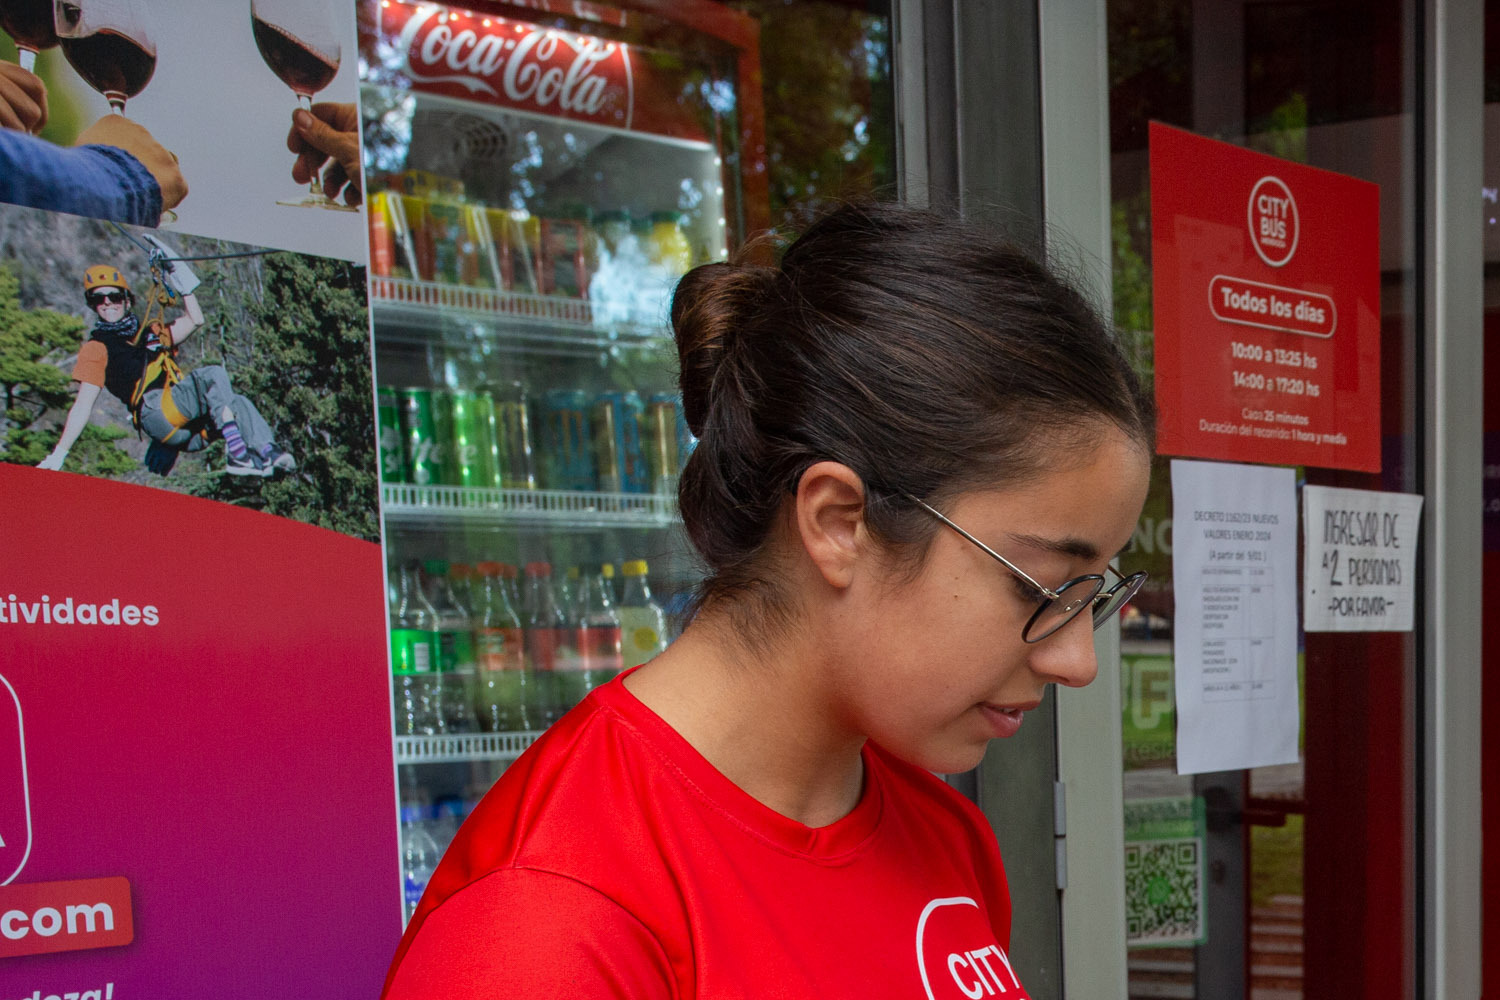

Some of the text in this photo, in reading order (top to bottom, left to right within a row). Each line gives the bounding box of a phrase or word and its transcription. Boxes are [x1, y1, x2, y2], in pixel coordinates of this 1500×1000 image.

[401, 2, 608, 115] Coca-Cola
[1257, 194, 1289, 220] CITY
[1260, 217, 1287, 240] BUS
[1221, 287, 1325, 324] Todos los días
[1231, 341, 1262, 362] 10:00
[1264, 348, 1272, 363] a
[1303, 351, 1317, 369] hs
[1233, 370, 1265, 390] 14:00
[1266, 377, 1274, 392] a
[1306, 380, 1320, 398] hs
[1199, 418, 1238, 435] Duración
[1275, 410, 1309, 426] minutos
[1322, 510, 1400, 549] INGRESAR DE
[1330, 550, 1343, 587] 2
[1348, 557, 1401, 588] PERSONAS
[947, 944, 1021, 1000] CITY
